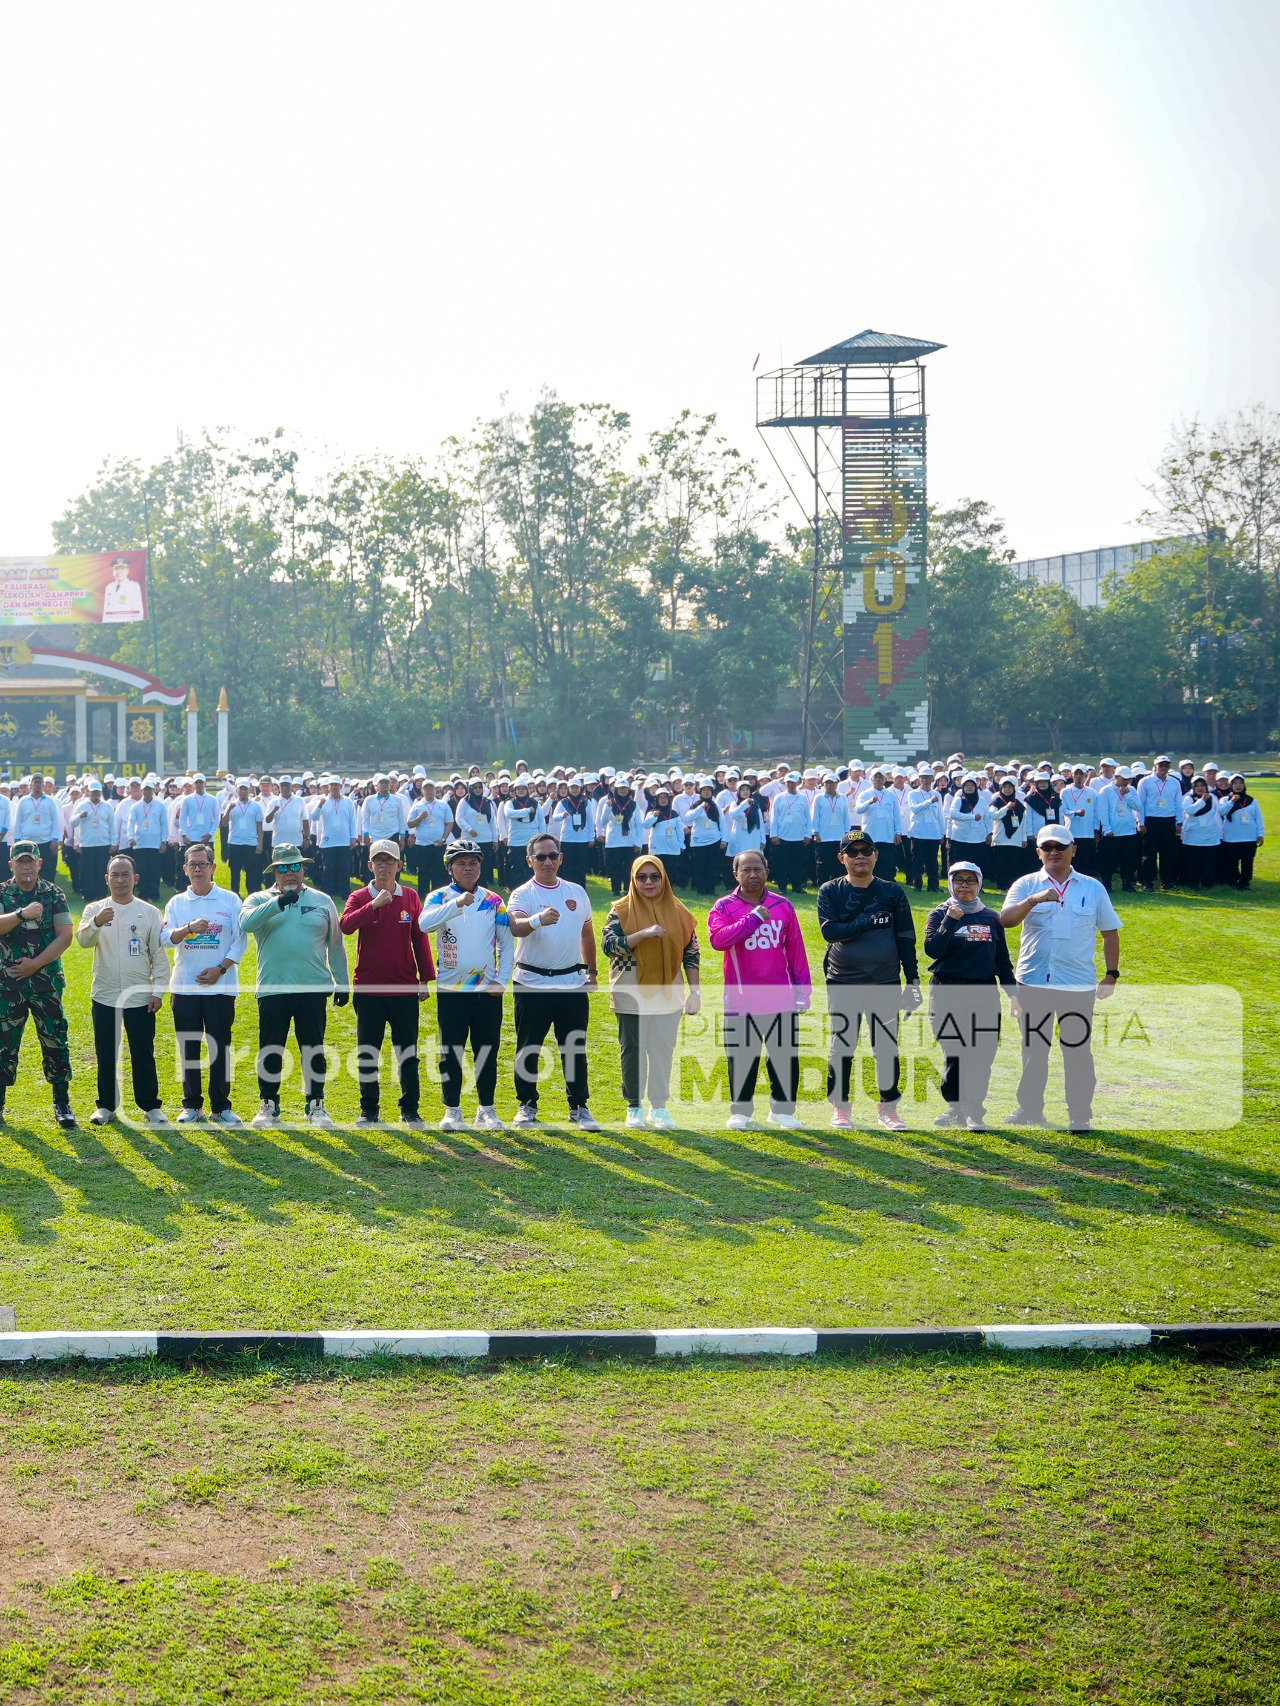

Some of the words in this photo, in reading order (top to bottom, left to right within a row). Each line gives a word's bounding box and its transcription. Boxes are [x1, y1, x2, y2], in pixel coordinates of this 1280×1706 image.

[42, 600, 72, 608] NEGERI
[873, 916, 890, 925] FOX
[911, 988, 921, 1002] FOX
